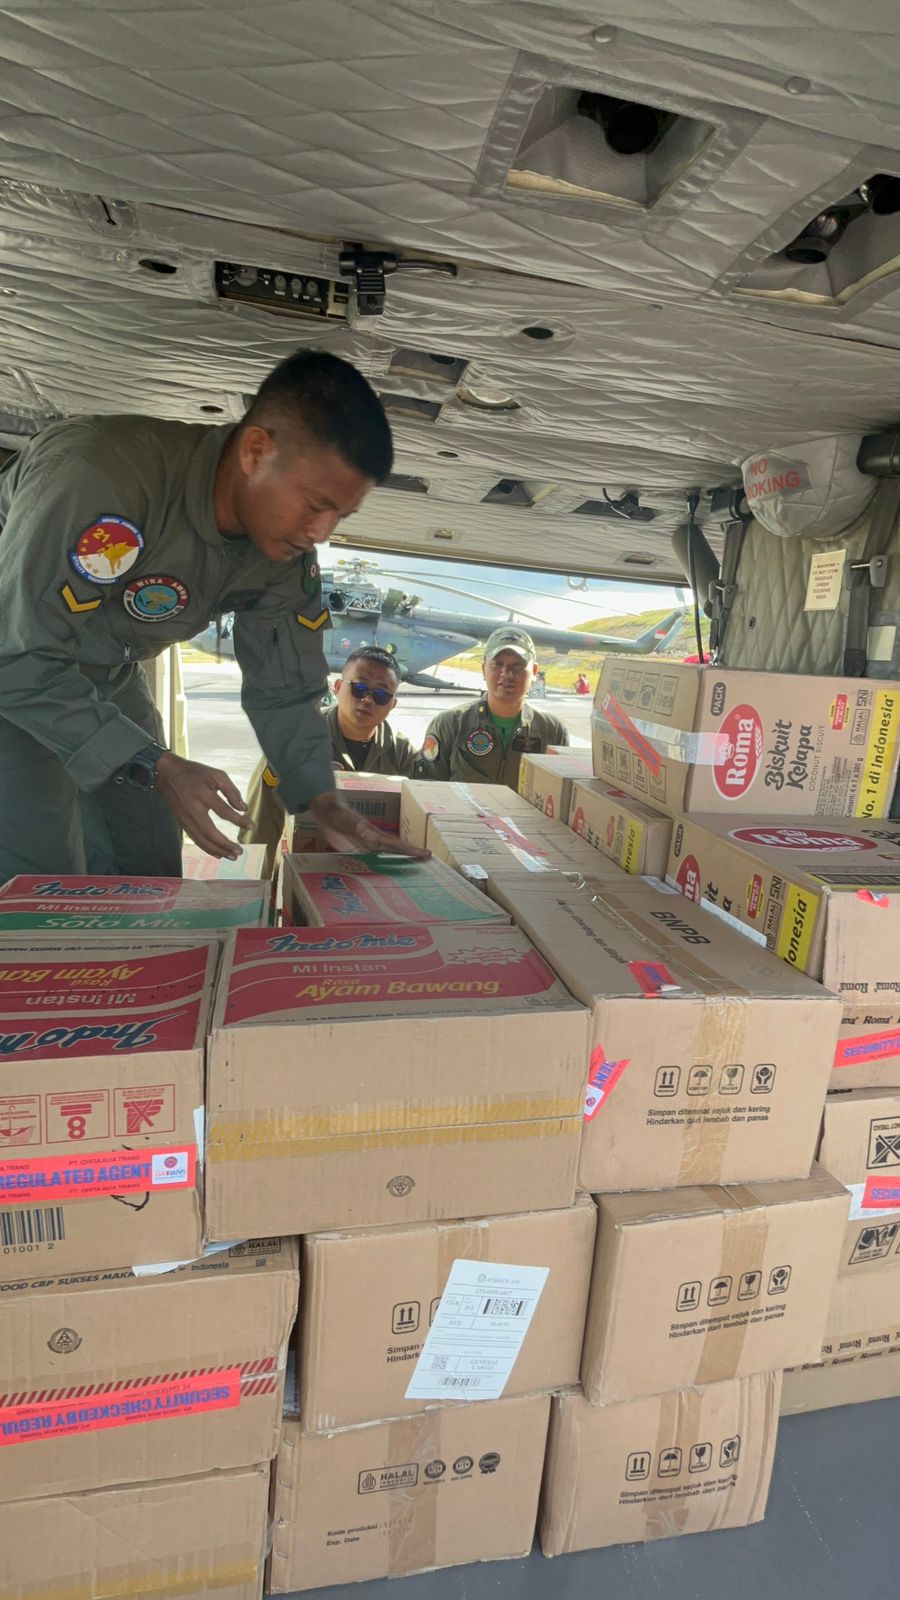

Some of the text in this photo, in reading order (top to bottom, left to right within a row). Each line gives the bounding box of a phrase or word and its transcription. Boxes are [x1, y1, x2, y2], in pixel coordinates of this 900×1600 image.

[751, 458, 768, 476] NO
[92, 528, 111, 543] 21
[136, 578, 163, 588] WIRA
[713, 686, 726, 714] PACK
[856, 689, 869, 707] SNI
[855, 712, 864, 732] HALAL
[872, 696, 894, 768] Indonesia
[725, 718, 755, 786] Roma
[764, 719, 793, 791] Biskuit
[785, 724, 815, 790] Kelapa
[808, 725, 826, 792] COCONUT BISCUIT
[867, 772, 880, 785] di
[751, 833, 864, 849] Roma
[770, 876, 782, 900] SNI
[63, 904, 120, 912] Instan
[37, 918, 120, 929] Soto
[767, 904, 776, 930] HALAL
[650, 911, 711, 945] BNPB
[784, 898, 808, 964] onesia
[53, 964, 144, 980] Ayam
[292, 963, 387, 974] Mi Instan
[71, 979, 112, 987] Rasa
[322, 978, 361, 986] Rasa
[840, 982, 868, 993] Roma
[295, 979, 500, 1002] Ayam Bawang
[25, 993, 137, 1006] Mi Instan
[841, 1016, 891, 1025] ma Roma
[647, 1109, 676, 1117] Simpan
[748, 1106, 771, 1114] kering
[646, 1117, 685, 1125] Hindarkan
[747, 1115, 769, 1123] panas
[67, 1116, 87, 1140] 8
[97, 1163, 152, 1182] AGENT
[3, 1242, 55, 1255] 01001 2
[249, 1241, 278, 1249] HALAL
[191, 1261, 230, 1272] Indonesia
[31, 1280, 55, 1288] CBP
[57, 1274, 100, 1286] SUKSES
[670, 1321, 698, 1331] Simpan
[751, 1308, 764, 1316] dan
[765, 1304, 786, 1313] kering
[669, 1328, 706, 1339] Hindarkan
[387, 1344, 420, 1355] Simpan
[822, 1345, 832, 1354] Ro
[386, 1352, 420, 1363] Hindark
[153, 1385, 230, 1410] SECURITY
[79, 1399, 150, 1423] CHECKED
[0, 1415, 51, 1436] REGUL
[55, 1411, 79, 1428] BY
[380, 1469, 414, 1481] HALAL
[619, 1496, 657, 1504] Hindarkan
[620, 1490, 648, 1498] Simpan
[327, 1529, 346, 1538] Kode
[347, 1523, 379, 1536] produksi
[343, 1536, 361, 1544] Date
